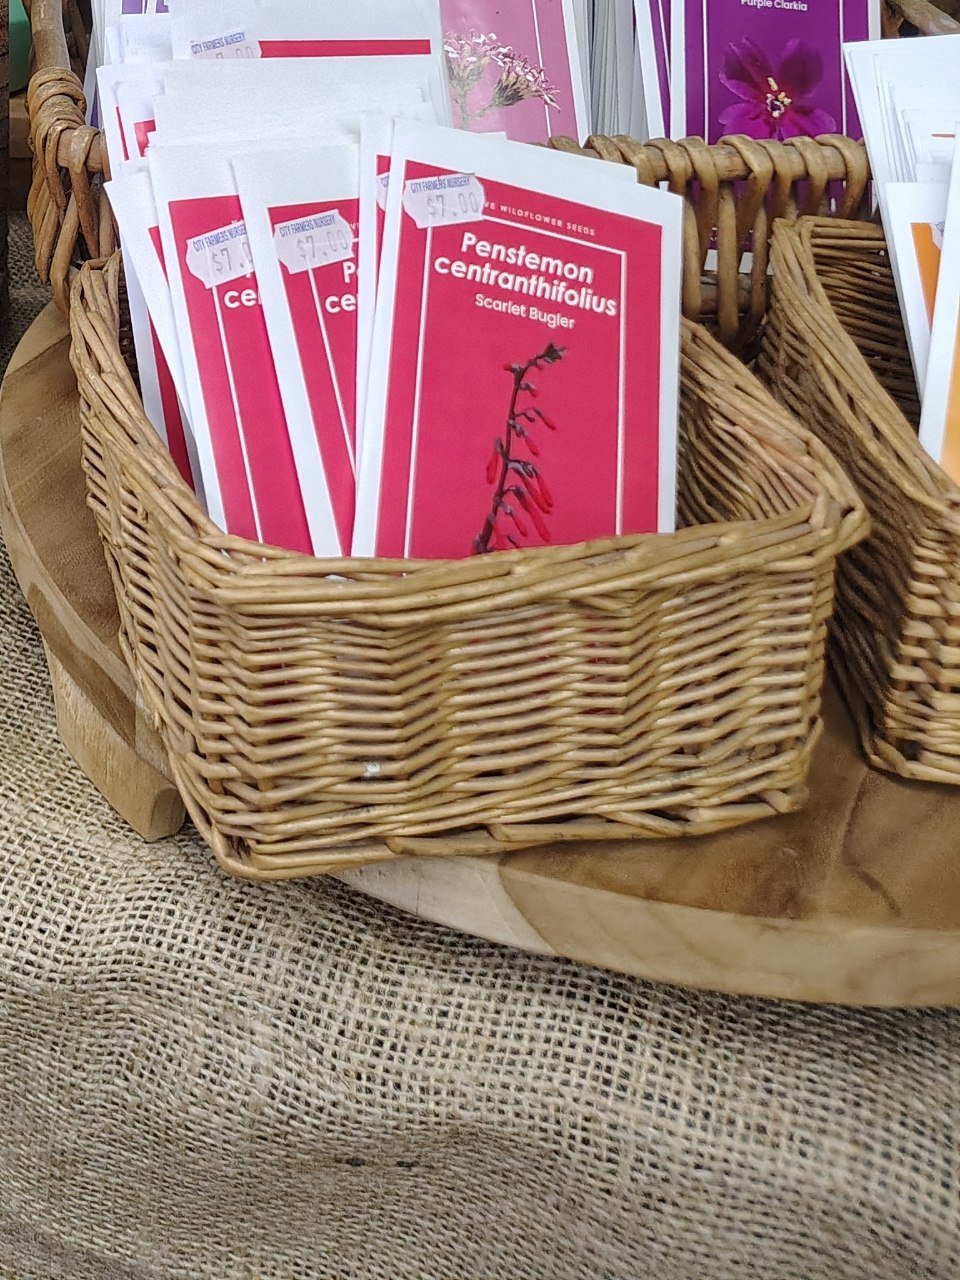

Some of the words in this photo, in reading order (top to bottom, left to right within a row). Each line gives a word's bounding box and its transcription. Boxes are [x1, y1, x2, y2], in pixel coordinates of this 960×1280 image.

[774, 0, 809, 12] Clarkia
[410, 182, 422, 194] CITY
[422, 179, 446, 192] FARMERS
[447, 176, 470, 189] NURSERY
[425, 191, 480, 219] $7.00
[500, 204, 563, 228] WILDFLOWER
[566, 221, 596, 236] SEEDS
[192, 240, 206, 253] CITY
[205, 230, 229, 247] FARMERS
[228, 223, 247, 239] NURSE
[279, 226, 292, 238] CITY
[291, 220, 314, 235] FARMERS
[313, 213, 336, 229] NURSERY
[211, 241, 254, 273] $7.0
[296, 229, 349, 261] $7.00
[460, 232, 595, 285] Penstemon
[434, 256, 618, 317] centranthifolius
[474, 293, 527, 319] Scarlet
[528, 306, 576, 330] Bugler
